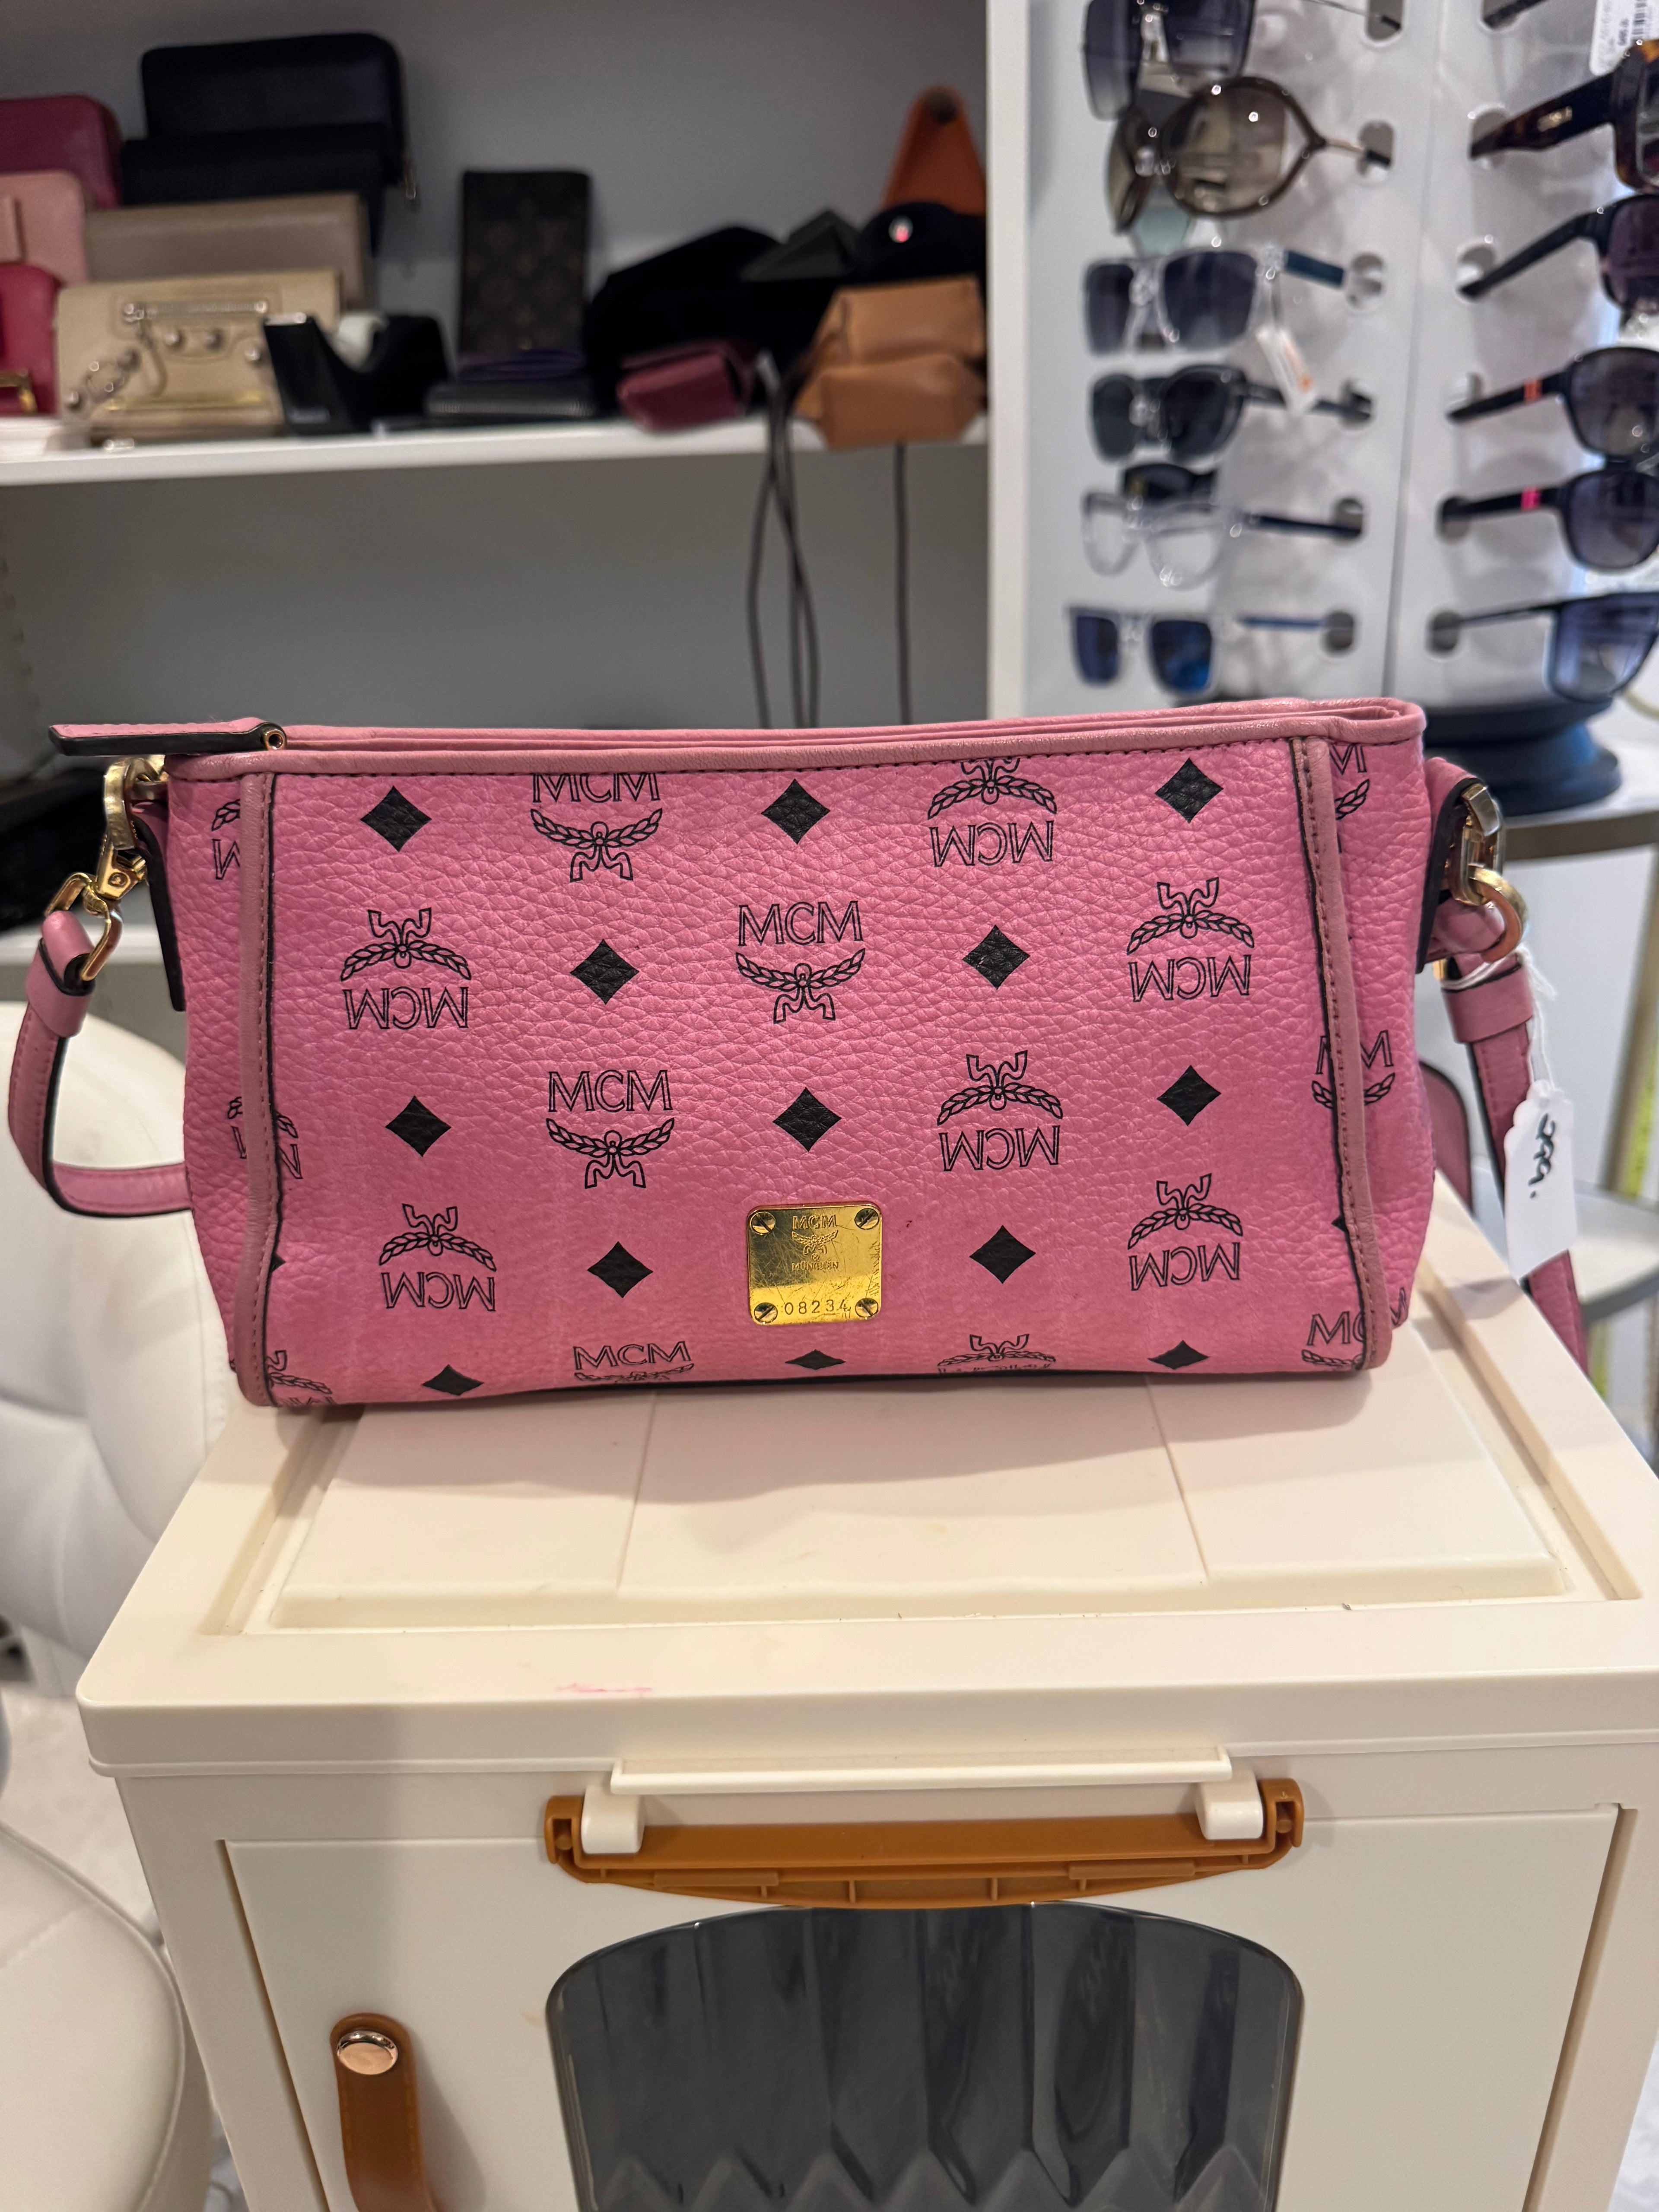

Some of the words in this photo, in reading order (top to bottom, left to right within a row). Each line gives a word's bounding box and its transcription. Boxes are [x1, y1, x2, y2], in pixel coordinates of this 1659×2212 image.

[532, 772, 661, 803] MCM
[929, 820, 1055, 867] MCM
[737, 900, 864, 947] MCM
[1128, 955, 1252, 1003] MCM
[342, 986, 469, 1030] MCM
[548, 1069, 673, 1113] MCM
[938, 1125, 1061, 1172] MCM
[792, 1214, 837, 1230] MCM
[1128, 1242, 1241, 1291] MCM
[381, 1272, 496, 1312] MCM
[784, 1299, 848, 1315] 08234
[572, 1341, 693, 1370] MCM
